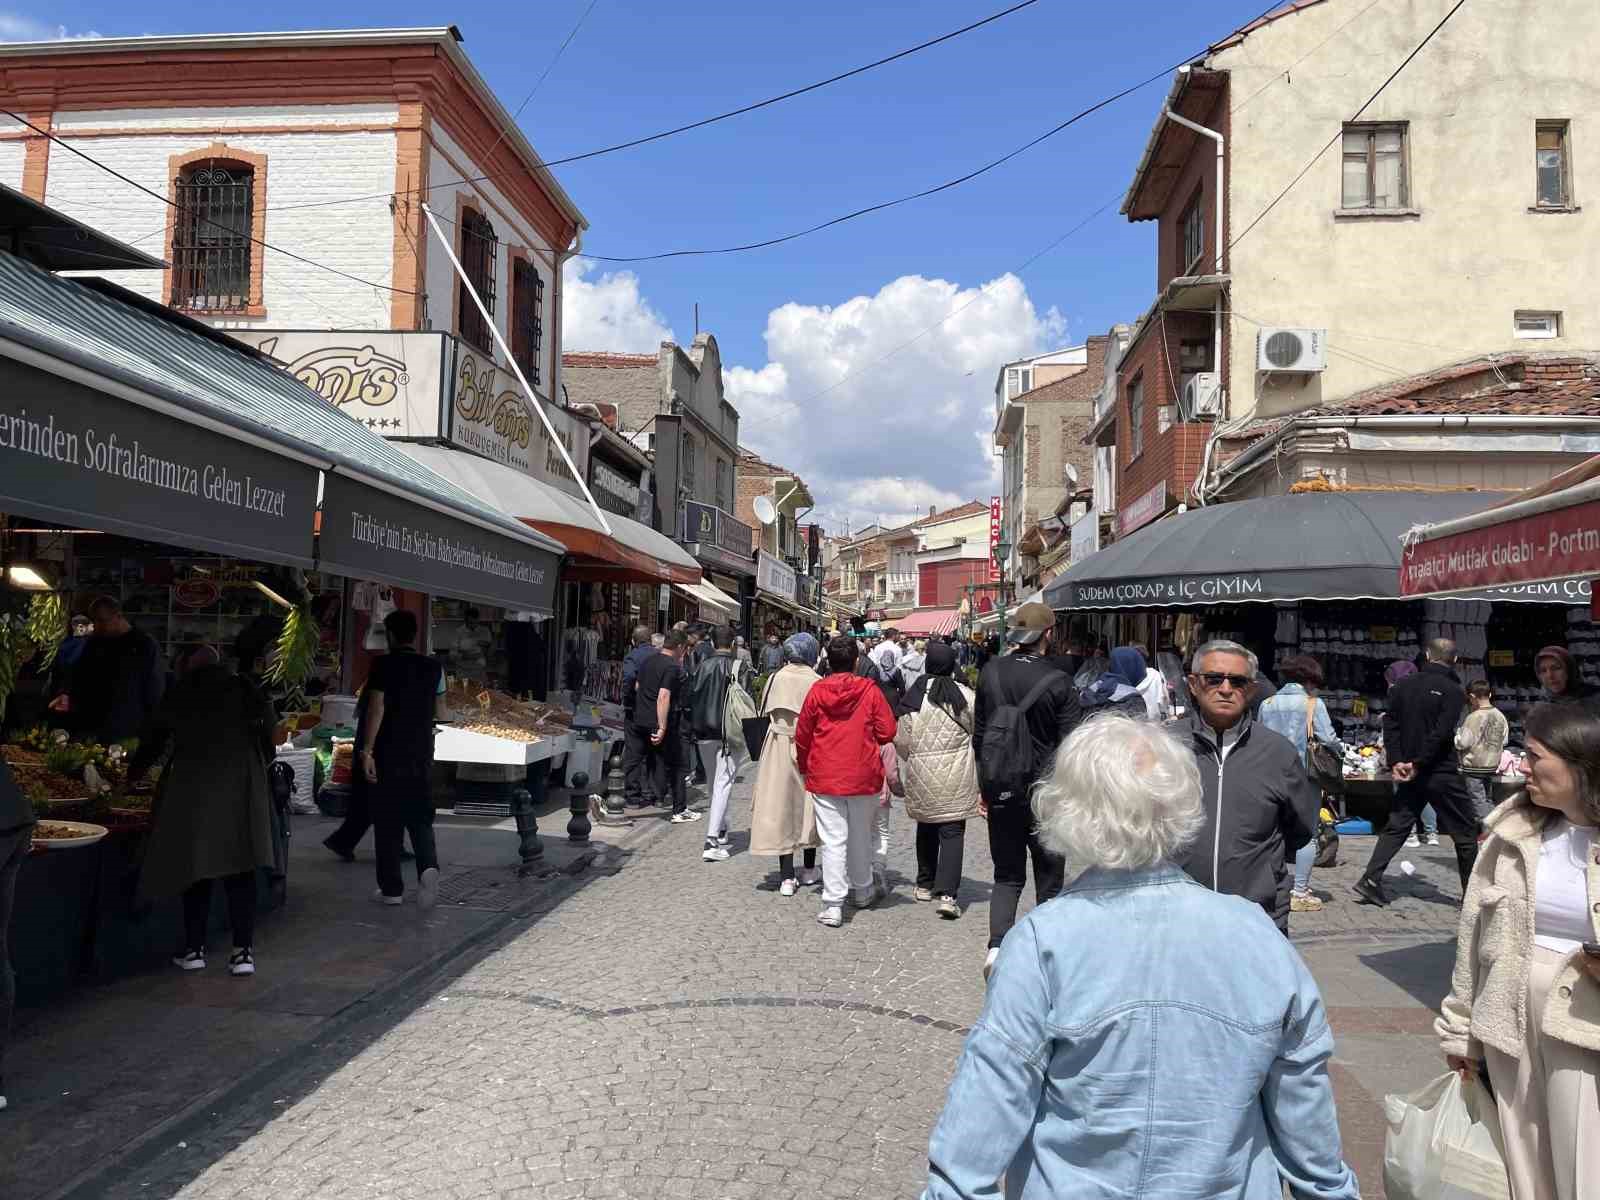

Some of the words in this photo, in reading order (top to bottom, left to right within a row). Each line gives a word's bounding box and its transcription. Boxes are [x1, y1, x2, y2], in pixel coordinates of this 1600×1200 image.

[84, 429, 200, 496] Sofralarımıza
[203, 464, 241, 507] Gelen
[246, 477, 286, 517] Lezzet
[402, 528, 411, 552] En
[1491, 539, 1535, 566] dolabı
[1549, 528, 1600, 557] Portm
[1079, 586, 1114, 601] SUDEM
[1116, 583, 1164, 601] ÇORAP
[1167, 584, 1176, 597] &
[1179, 575, 1197, 599] İÇ
[1201, 575, 1262, 597] GİYİM
